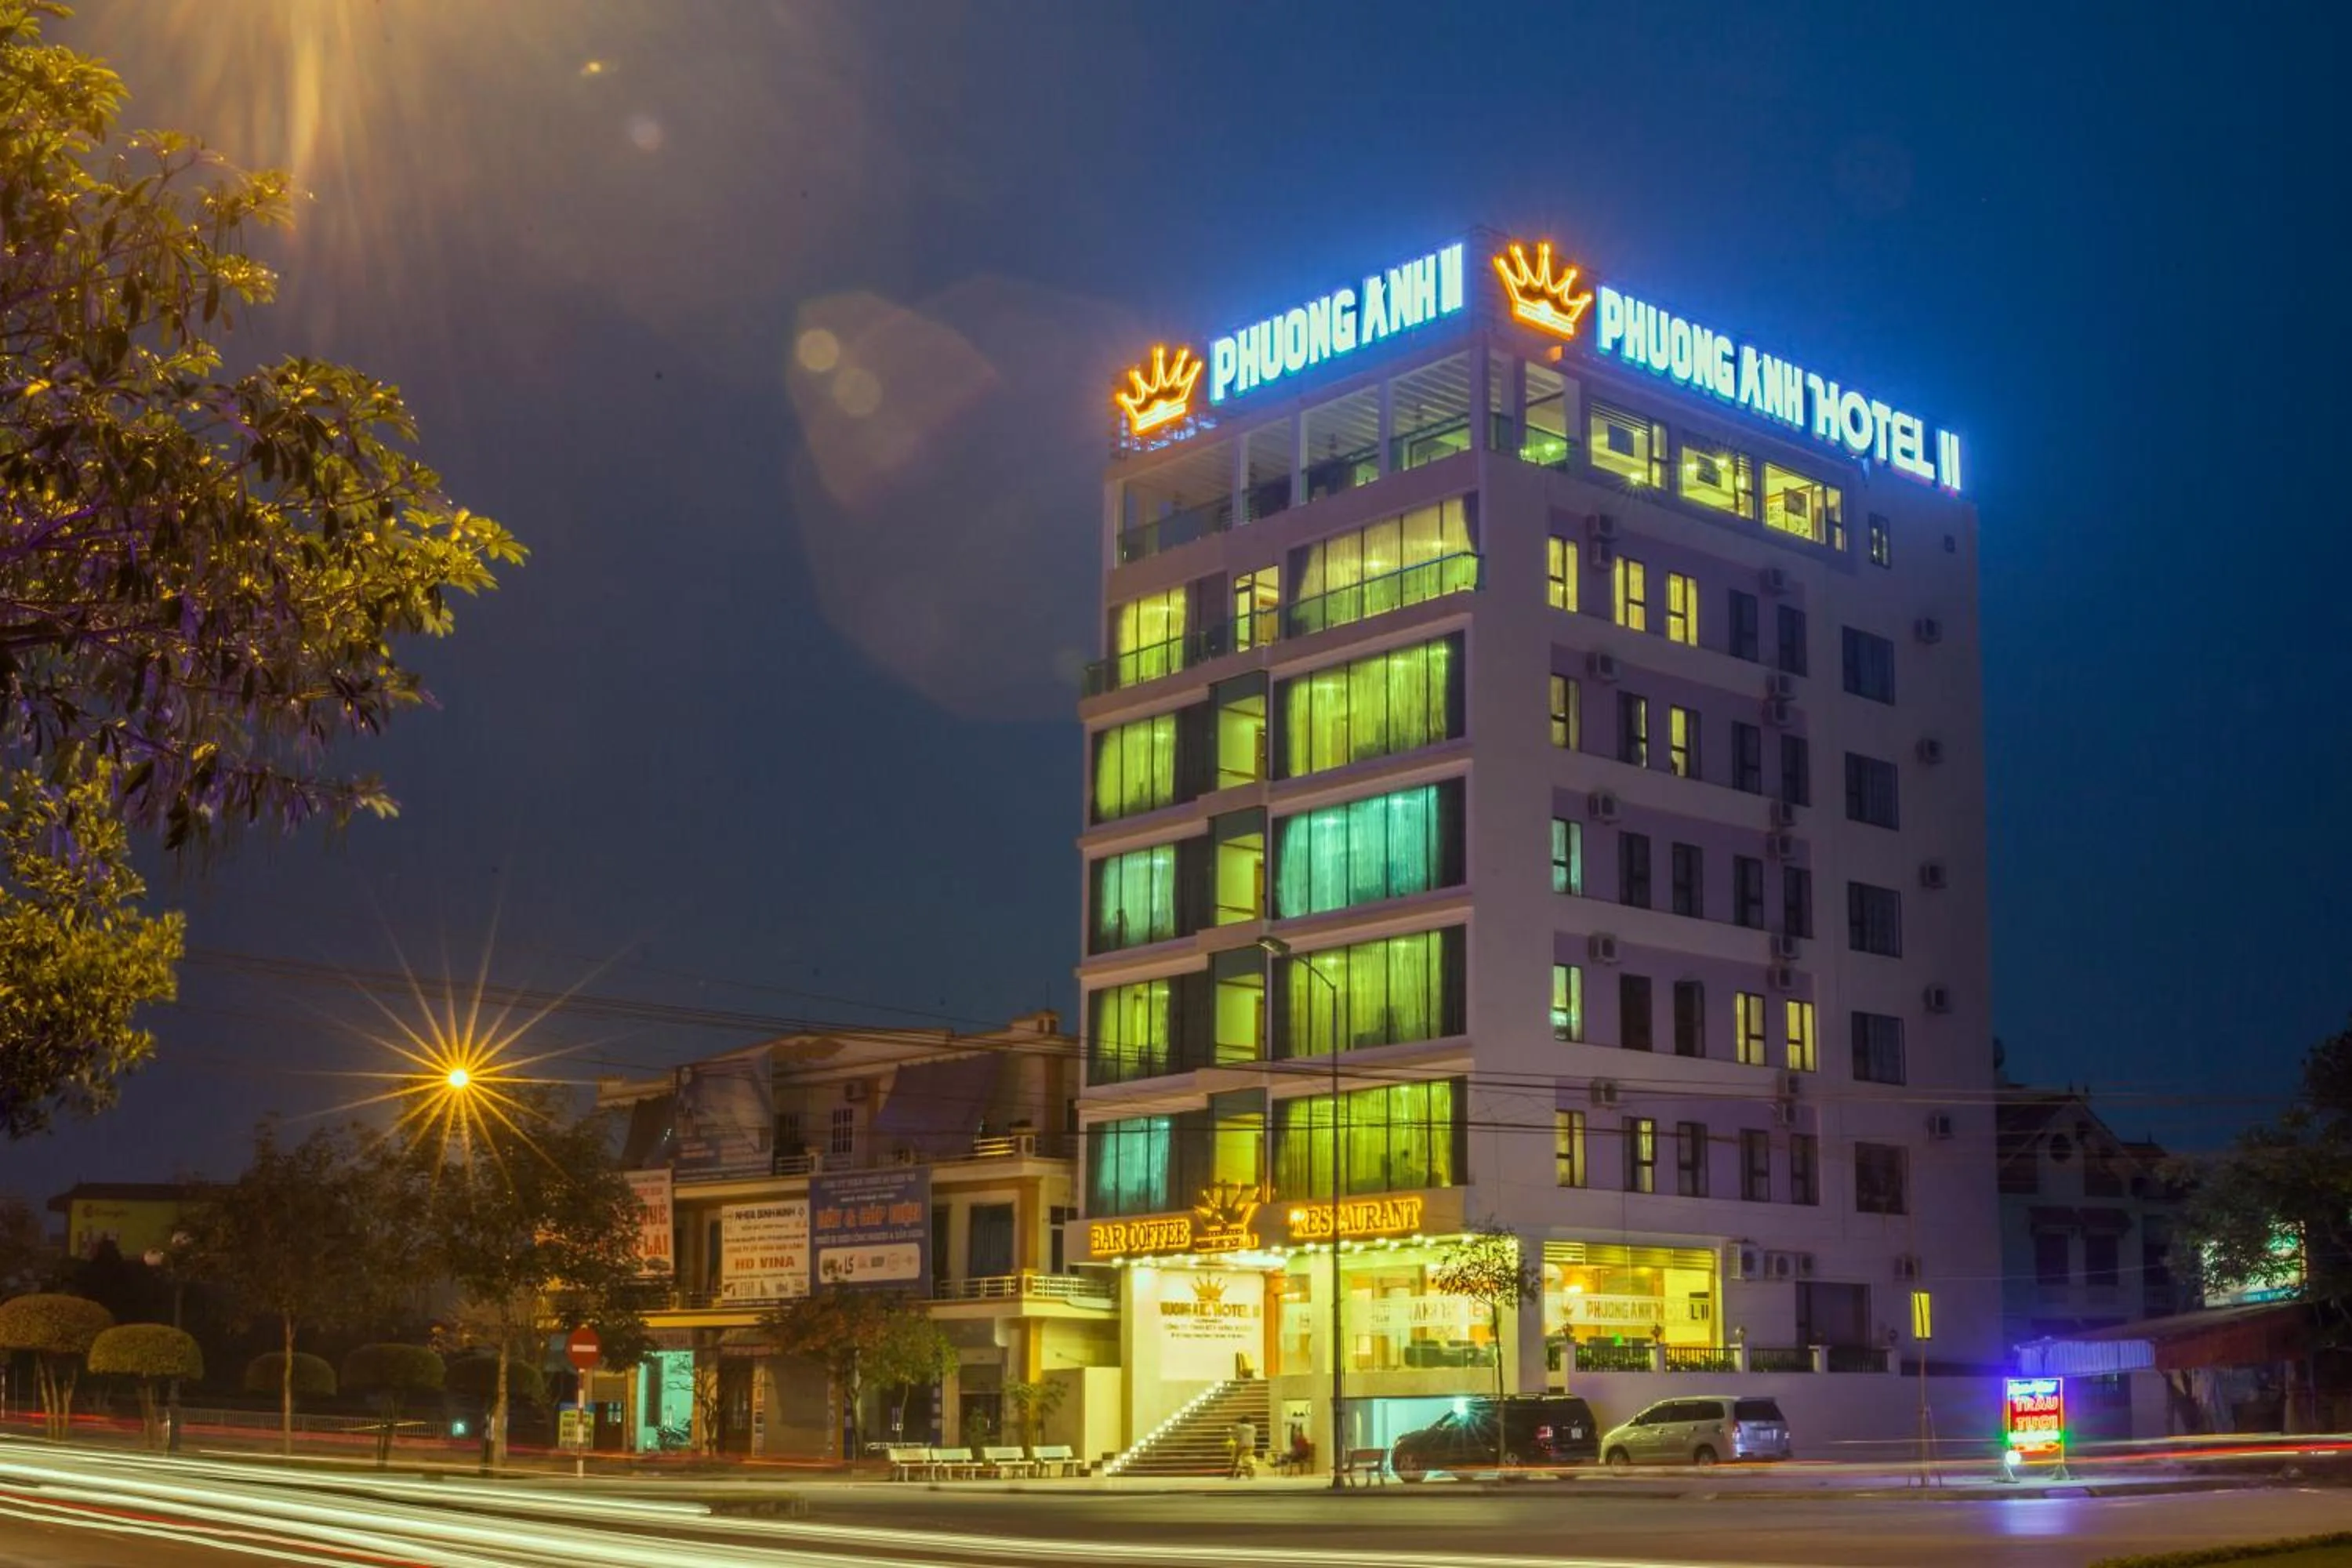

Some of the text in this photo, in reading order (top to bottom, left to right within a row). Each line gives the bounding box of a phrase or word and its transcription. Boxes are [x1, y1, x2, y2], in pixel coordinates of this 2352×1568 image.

[1211, 288, 1357, 403] PHUONG
[1599, 285, 1735, 398] PHUONG
[1806, 372, 1936, 481] HOTEL
[1937, 427, 1961, 491] II
[1091, 1225, 1126, 1254] BAR
[1129, 1219, 1190, 1251] COFFEE
[1290, 1196, 1421, 1237] RESAURANT
[760, 1256, 795, 1268] VINA
